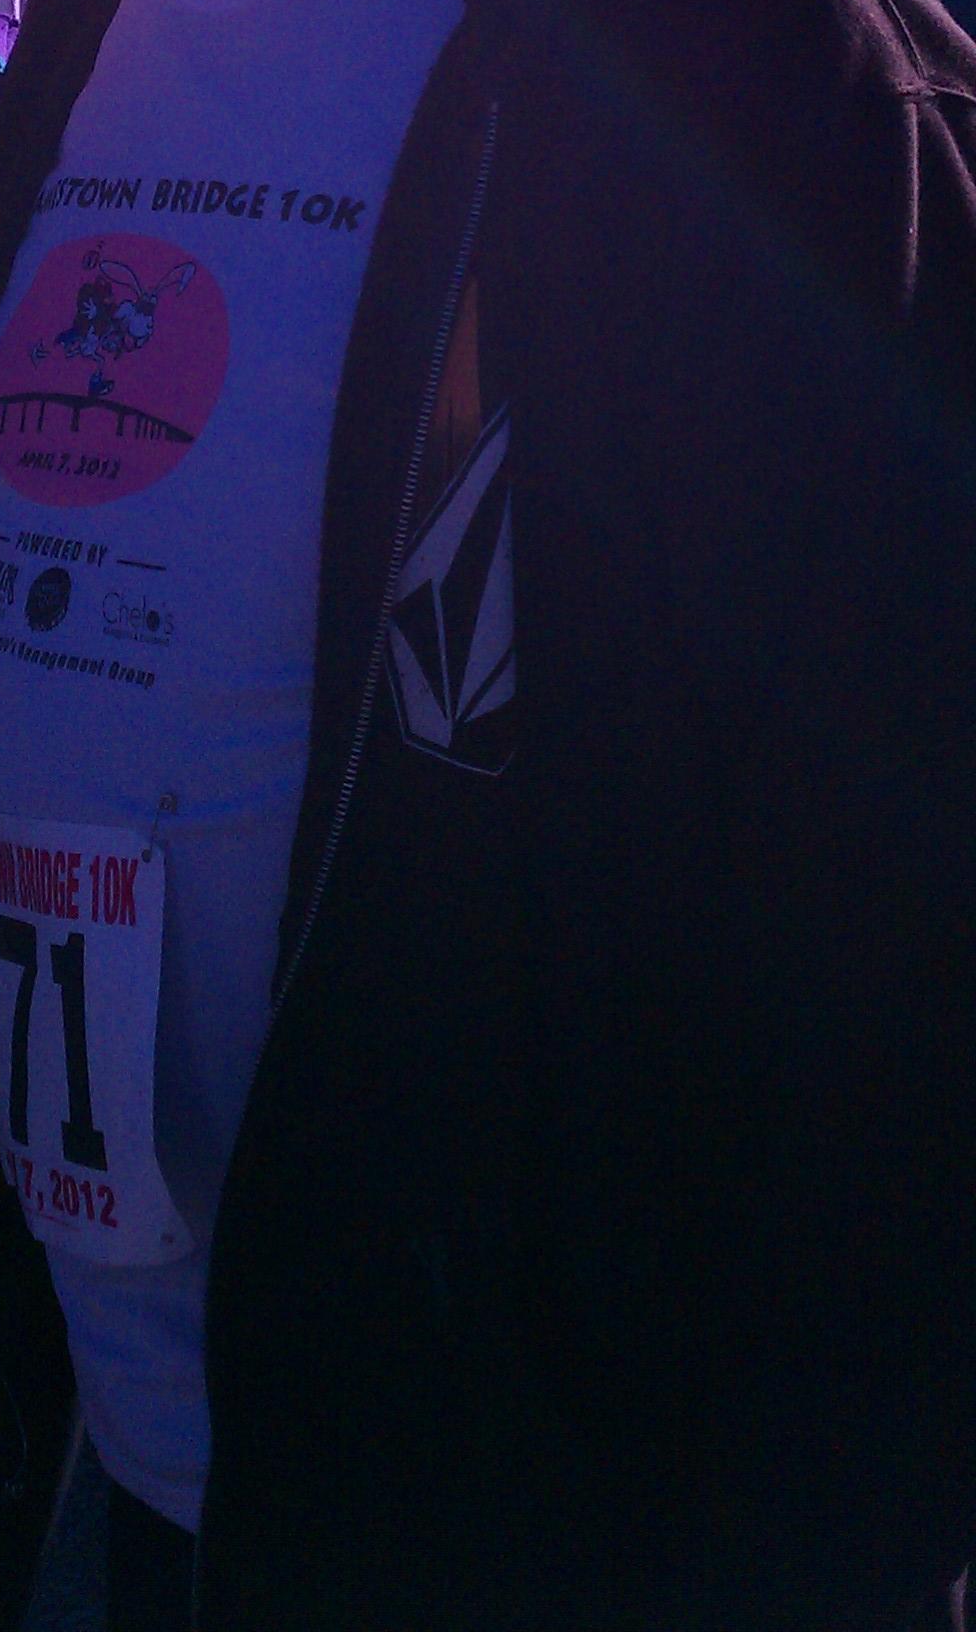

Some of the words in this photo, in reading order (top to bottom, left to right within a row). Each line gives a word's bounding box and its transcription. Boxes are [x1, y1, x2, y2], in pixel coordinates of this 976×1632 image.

[152, 178, 270, 219] BRIDGE
[280, 189, 367, 232] 10K
[17, 844, 81, 920] BRIDGE
[89, 855, 138, 927] 10K
[49, 1169, 118, 1229] 2012
